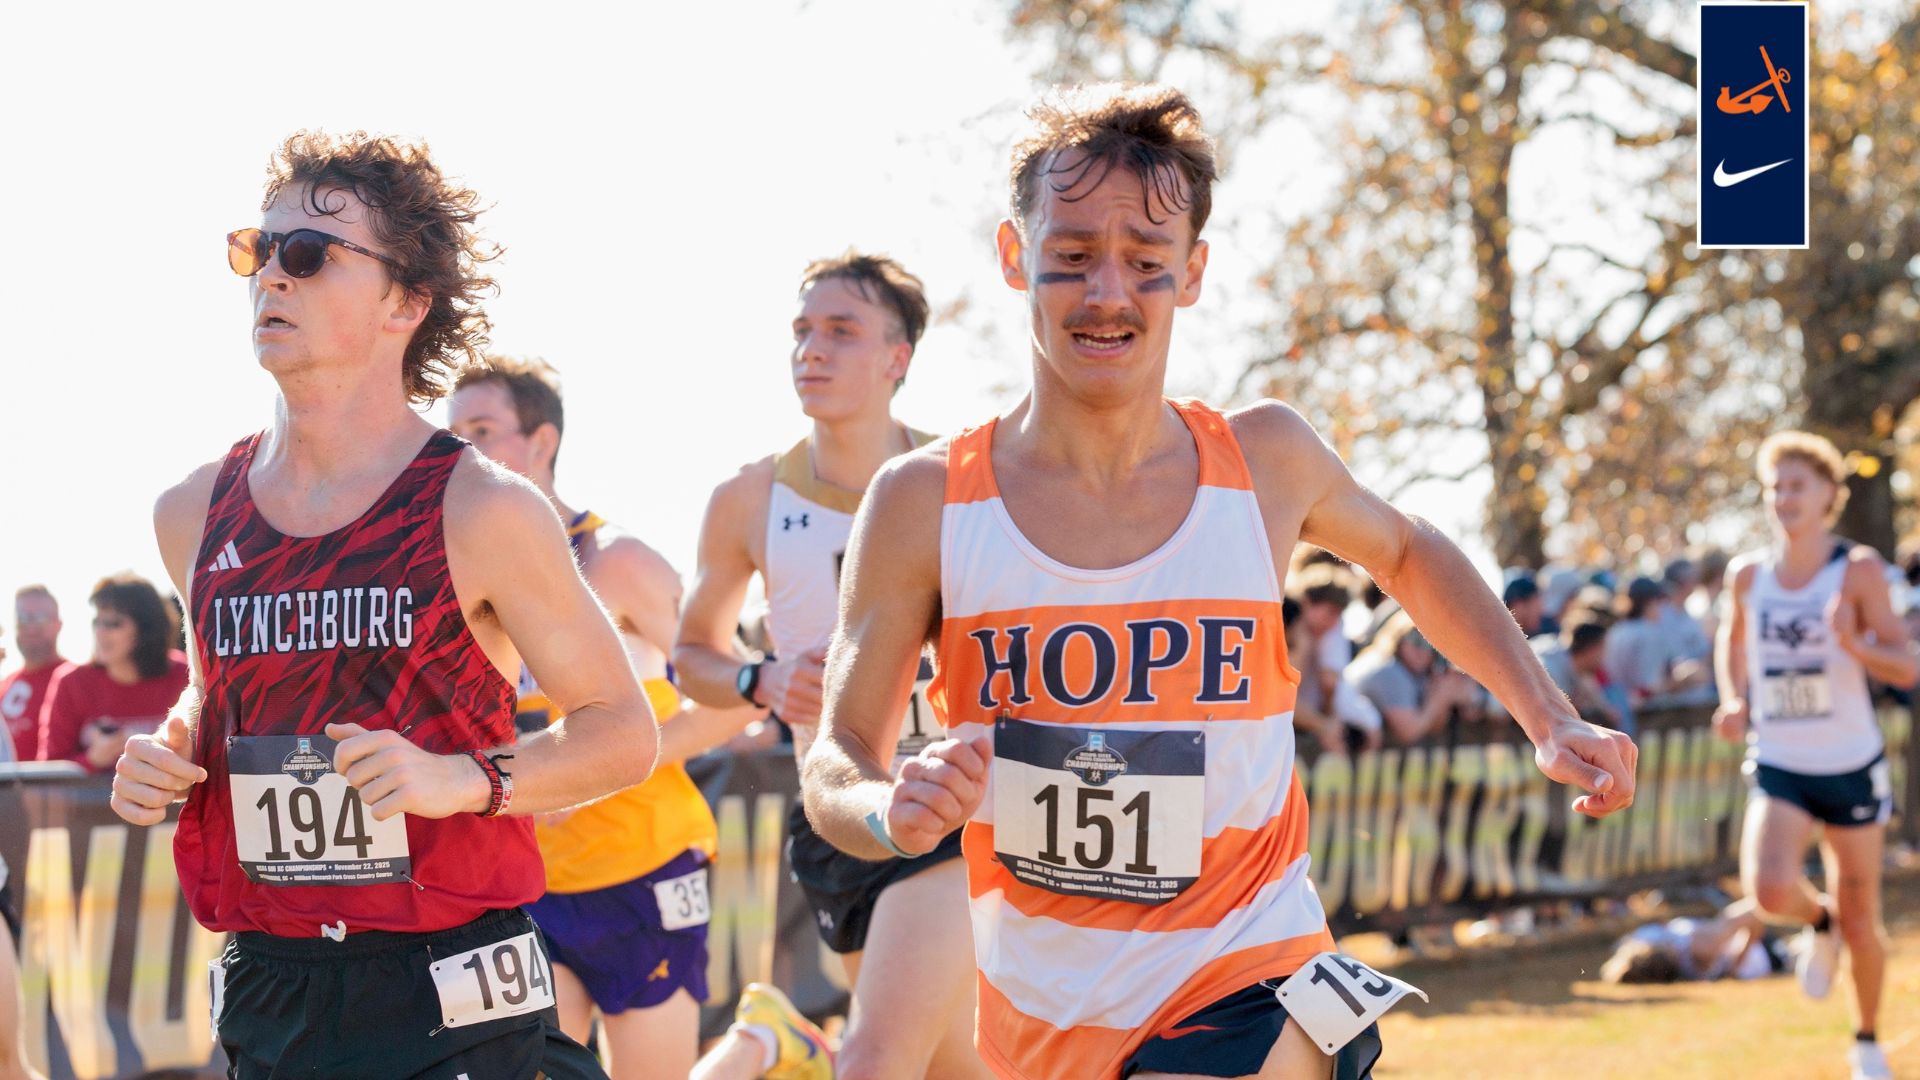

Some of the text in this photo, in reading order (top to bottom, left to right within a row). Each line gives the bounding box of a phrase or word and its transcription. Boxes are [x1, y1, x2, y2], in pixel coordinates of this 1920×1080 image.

[214, 587, 413, 656] LYNCHBURG
[968, 616, 1257, 710] HOPE
[283, 762, 330, 771] CHAMPIONSHIPS
[1065, 759, 1126, 771] CHAMPIONSHIPS
[256, 785, 373, 861] 194
[1033, 784, 1157, 875] 151
[285, 864, 327, 872] CHAMPIONSHIPS
[334, 863, 361, 871] November
[374, 861, 390, 869] 2025
[1052, 869, 1103, 882] CHAMPIONSHIPS
[1112, 876, 1146, 888] November
[1160, 880, 1178, 889] 2025
[463, 937, 548, 1010] 194
